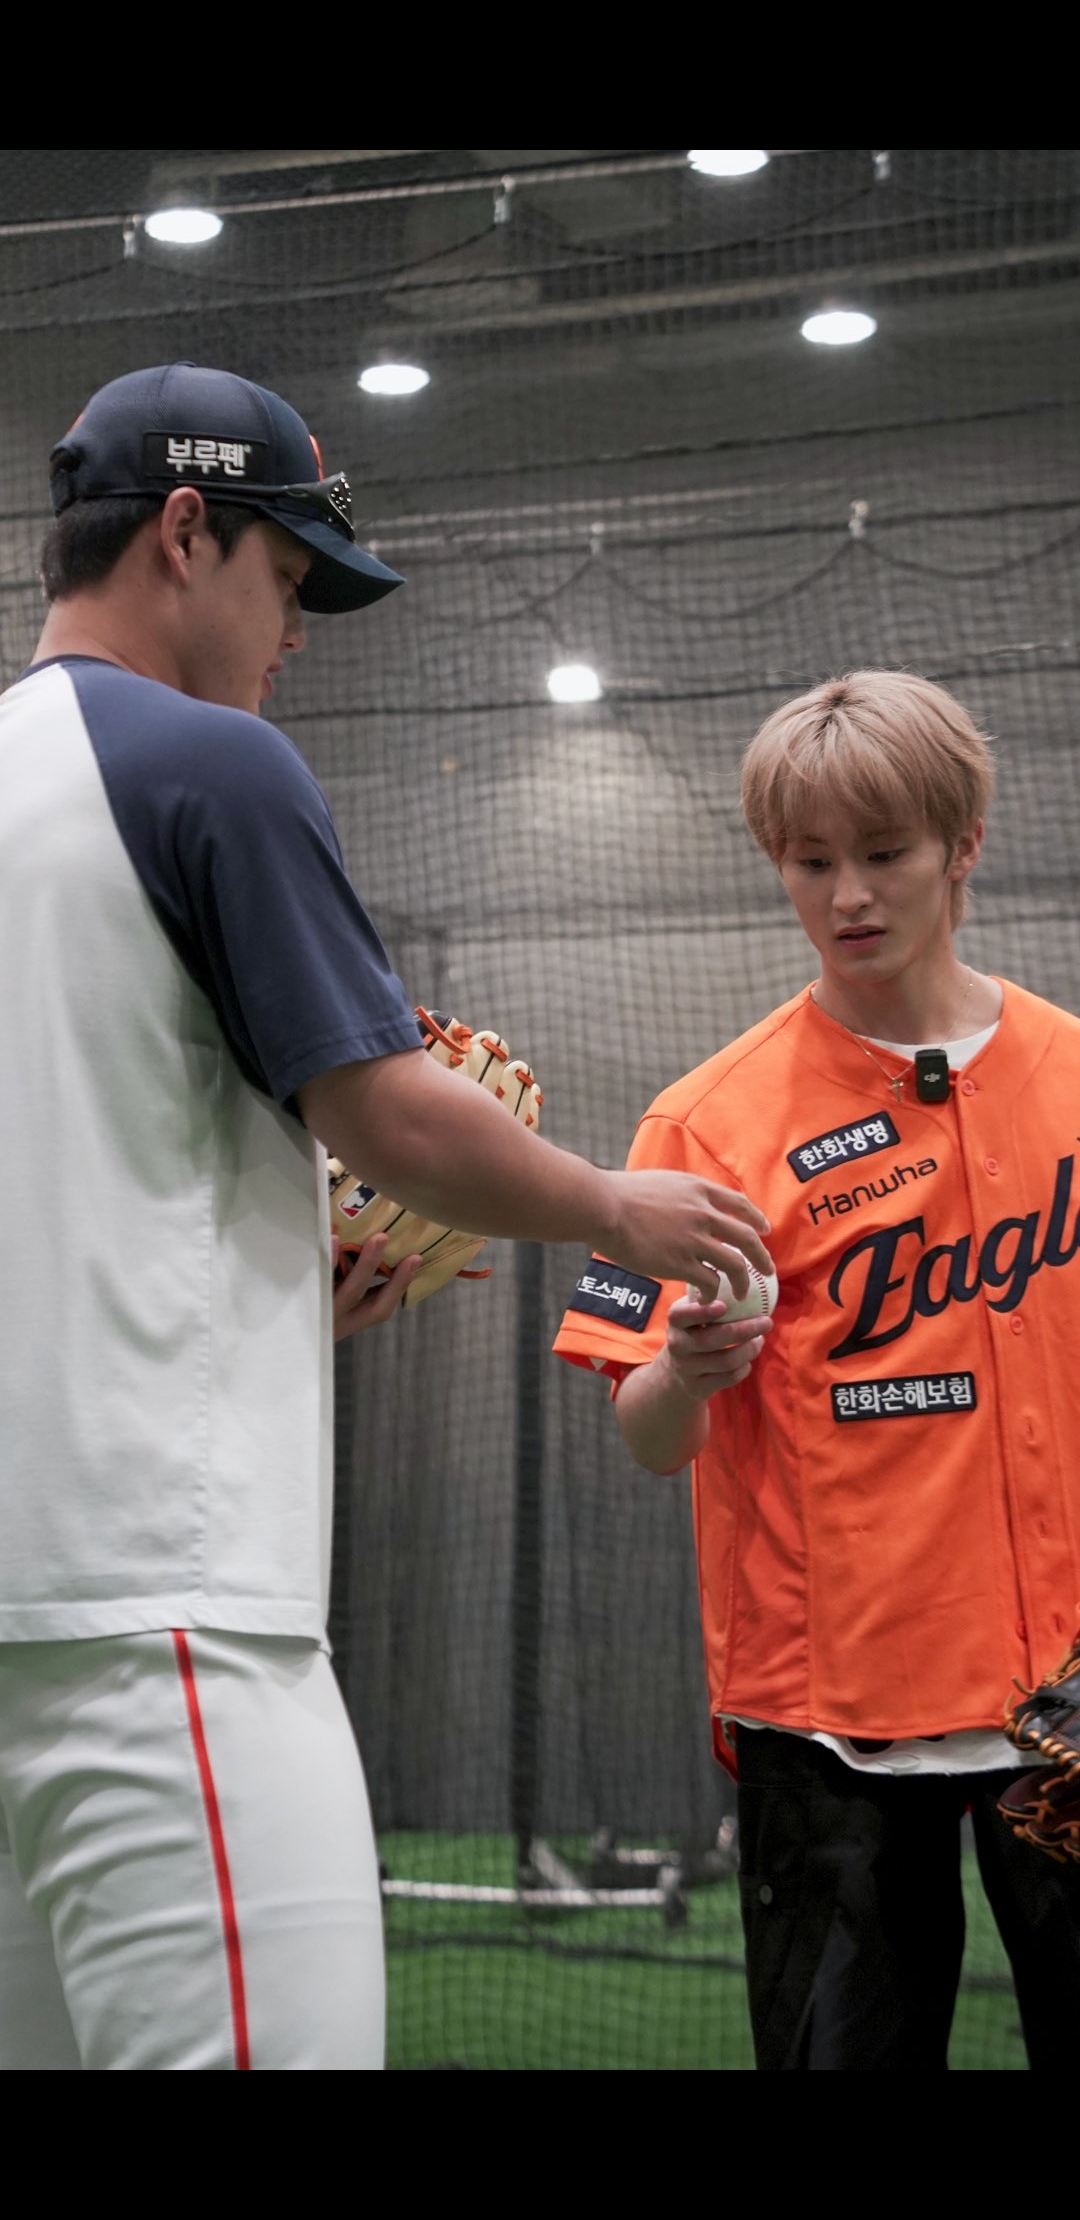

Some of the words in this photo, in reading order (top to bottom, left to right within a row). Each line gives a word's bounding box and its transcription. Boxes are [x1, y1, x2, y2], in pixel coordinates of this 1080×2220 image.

[798, 1119, 889, 1171] 한화생명
[807, 1157, 938, 1226] Hanwha
[827, 1153, 1080, 1361] Eagl
[578, 1276, 648, 1314] 토스페이
[834, 1376, 973, 1416] 한화손해보험
